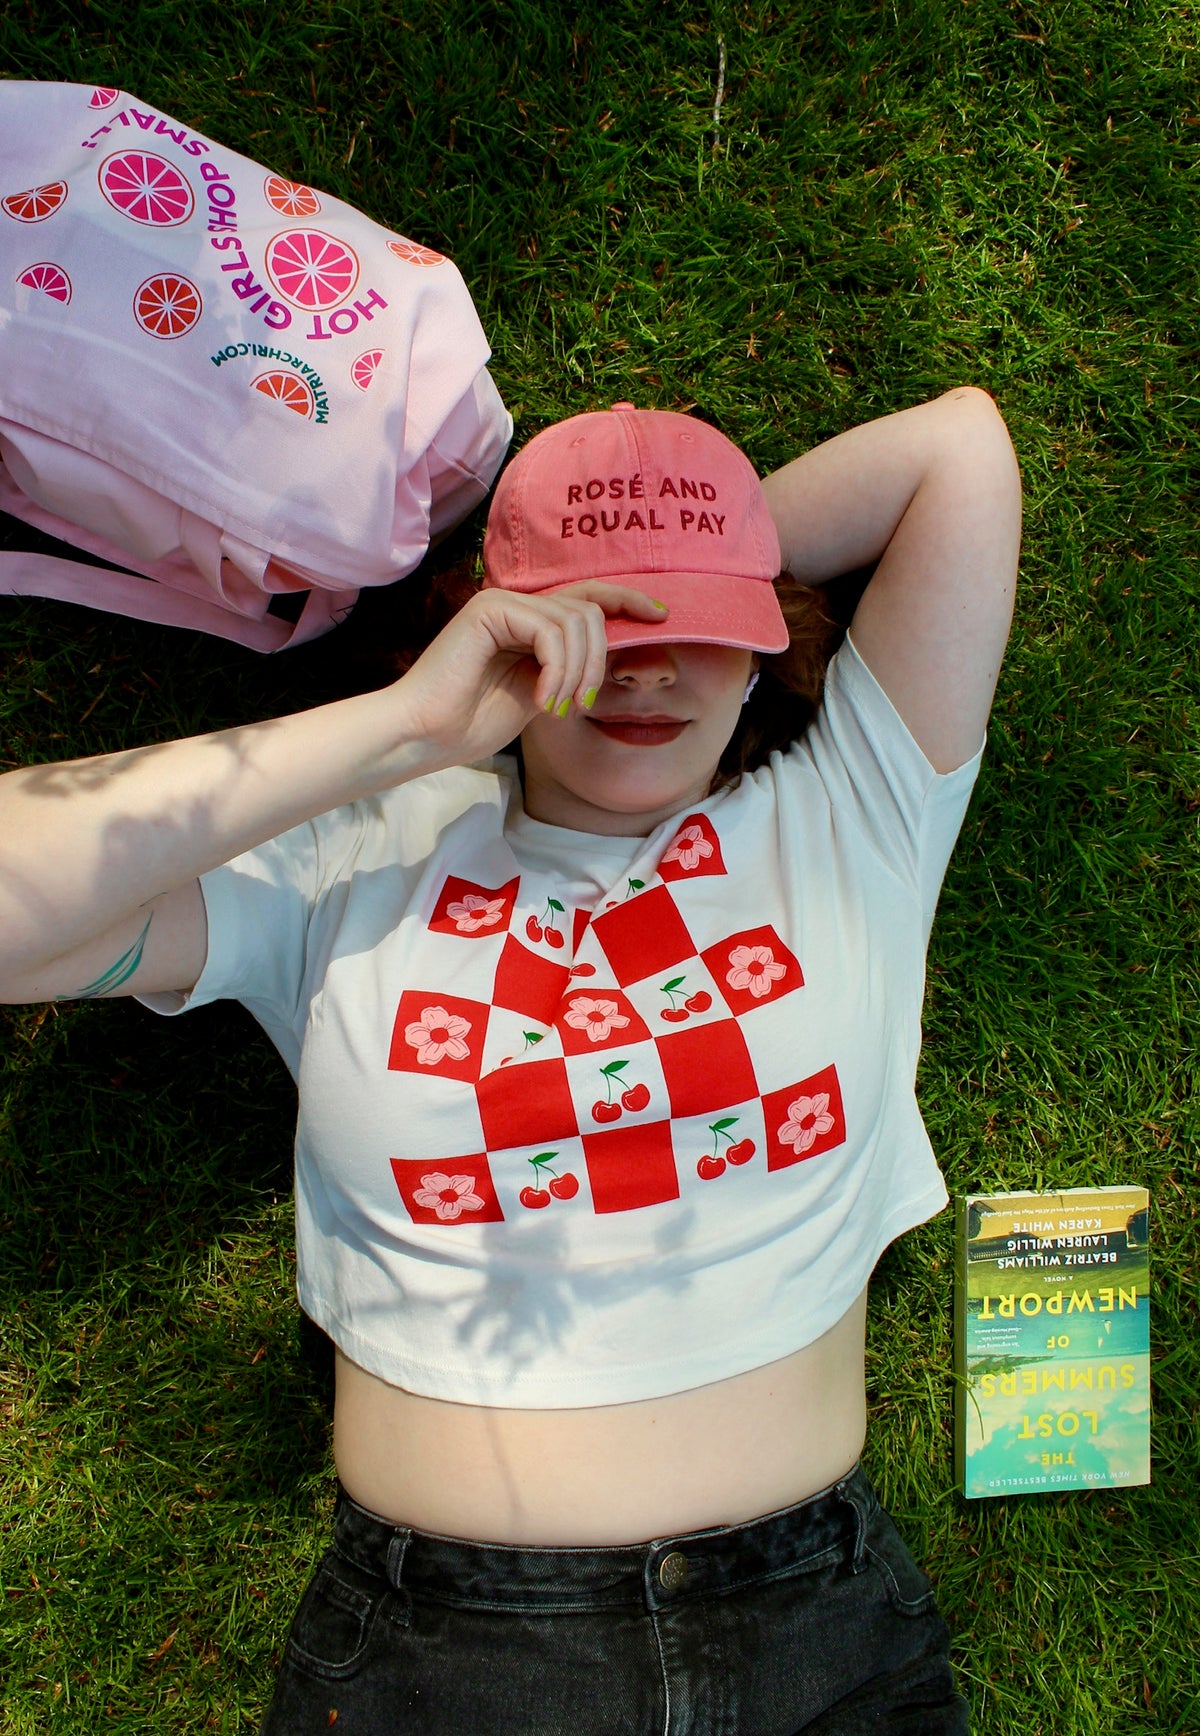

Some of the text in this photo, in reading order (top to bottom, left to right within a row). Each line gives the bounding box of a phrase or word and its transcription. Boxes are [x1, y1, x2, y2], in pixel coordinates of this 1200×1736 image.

[199, 162, 238, 233] SHOP
[210, 236, 292, 330] GIRLS
[306, 288, 389, 340] HOT
[210, 343, 329, 424] MATRIARCHRI.COM
[567, 473, 717, 505] ROSÉ AND
[561, 509, 726, 539] EQUAL PAY
[1013, 1218, 1101, 1233] KAREN WHITE
[1007, 1235, 1108, 1251] LAUREN WILLIG
[997, 1252, 1117, 1269] BEATRIZ WILLIAMS
[977, 1285, 1137, 1320] NEWPORT
[1047, 1335, 1070, 1349] OF
[980, 1363, 1135, 1398] SUMMERS
[1017, 1410, 1098, 1439] LOST
[1040, 1452, 1074, 1466] THE
[989, 1471, 1130, 1487] NEW YORK TIMES BESTSELLER
